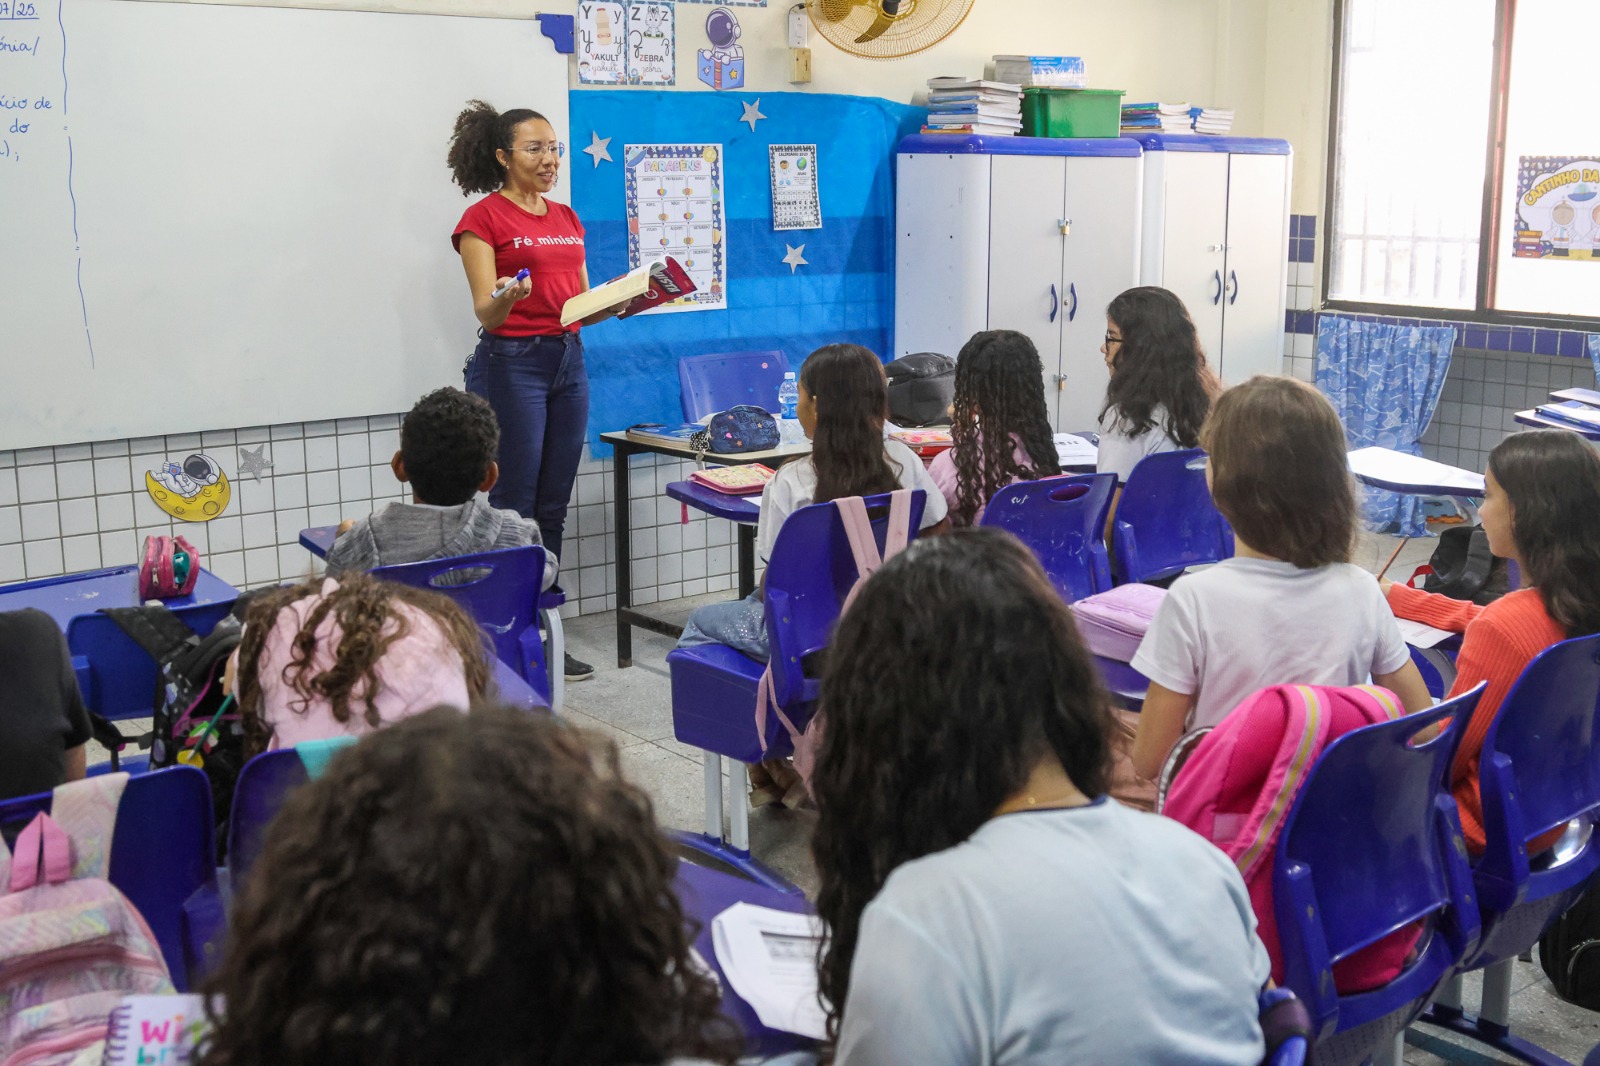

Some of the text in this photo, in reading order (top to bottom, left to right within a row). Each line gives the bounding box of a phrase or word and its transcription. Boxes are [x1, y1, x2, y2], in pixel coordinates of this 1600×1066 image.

[582, 5, 592, 19] Y
[614, 10, 622, 24] y
[631, 7, 641, 21] Z
[591, 53, 619, 61] YAKULT
[591, 61, 619, 75] yakult
[642, 62, 662, 76] zebra
[34, 96, 52, 110] de
[9, 118, 30, 133] do
[644, 160, 702, 172] PARABÉNS
[1524, 169, 1599, 206] CANTINHO DA
